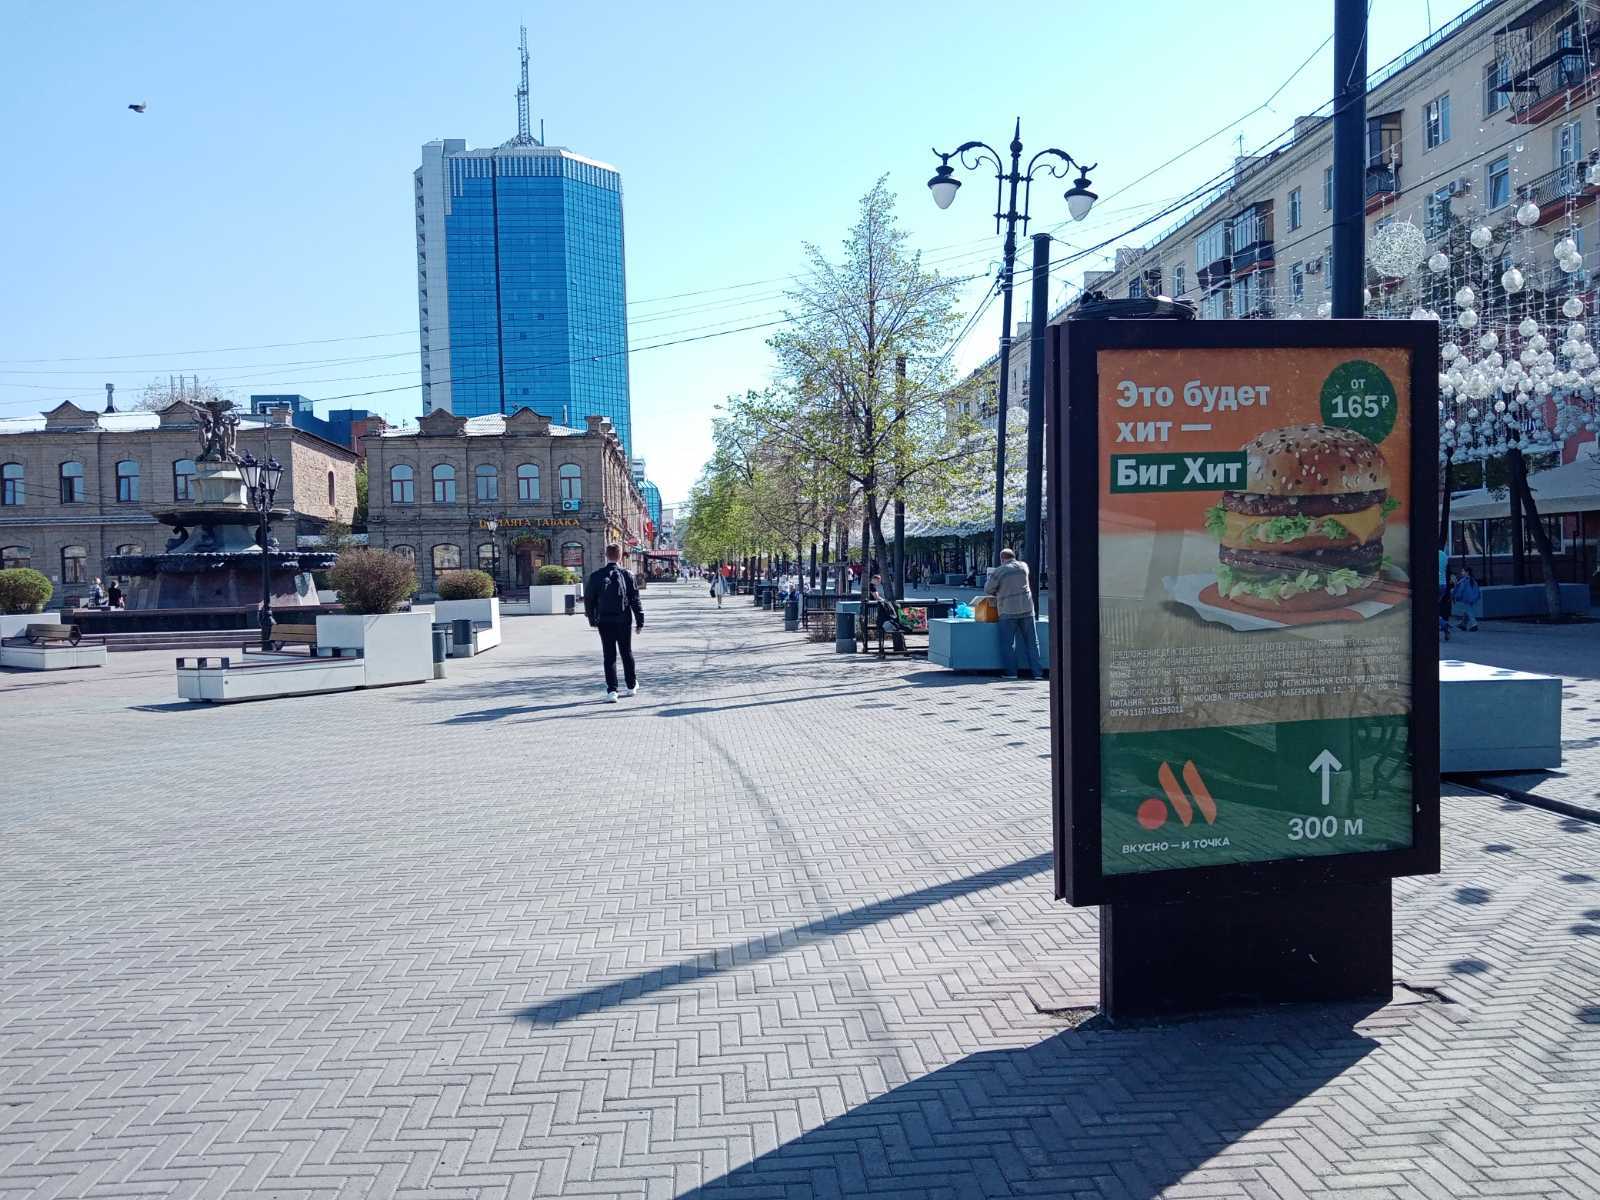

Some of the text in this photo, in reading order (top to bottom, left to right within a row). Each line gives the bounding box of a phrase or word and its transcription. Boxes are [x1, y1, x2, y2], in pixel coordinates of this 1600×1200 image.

[1116, 380, 1270, 413] Это будет
[1116, 421, 1173, 443] хит
[1117, 457, 1242, 487] Биг Хит
[1287, 815, 1338, 841] 300
[1121, 842, 1169, 855] ВКУСНО
[1192, 837, 1231, 849] ТОЧКА
